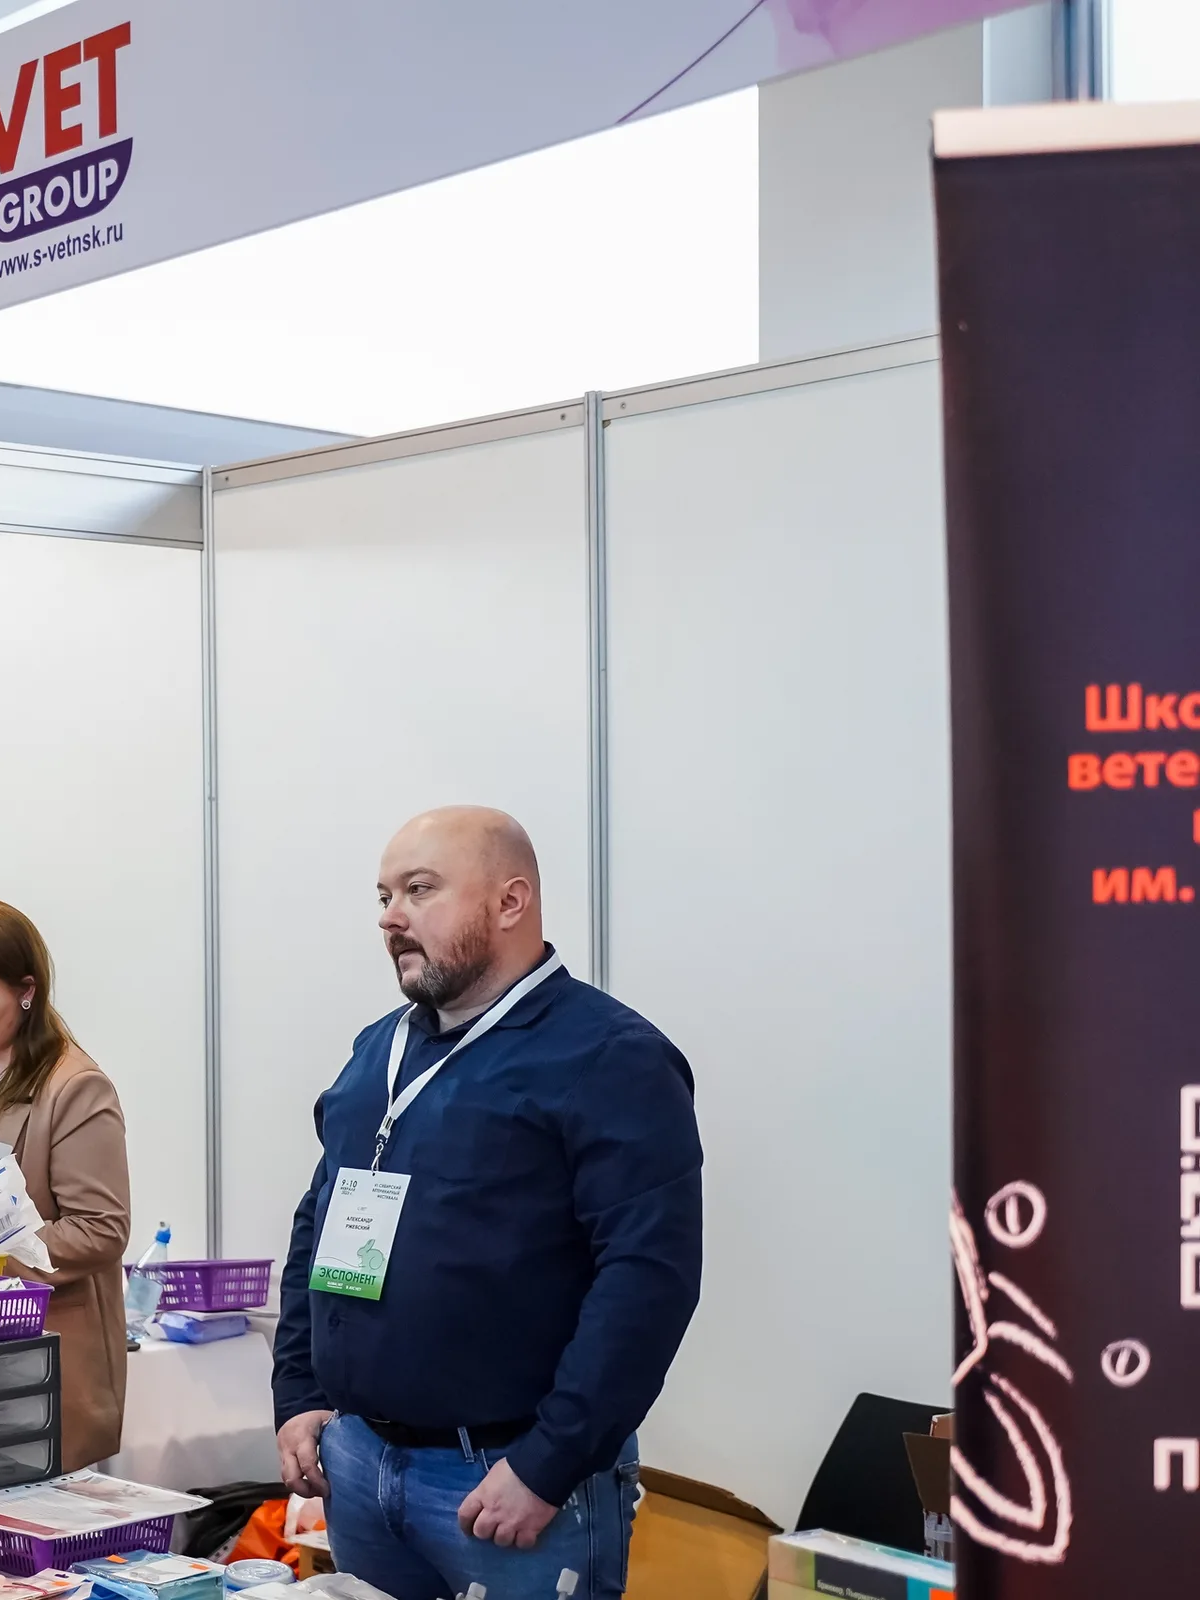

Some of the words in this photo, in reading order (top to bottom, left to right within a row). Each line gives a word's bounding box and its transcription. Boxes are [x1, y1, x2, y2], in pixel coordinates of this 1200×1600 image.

[1067, 750, 1200, 791] вете
[1091, 865, 1196, 905] им.
[318, 1267, 377, 1286] ЭКСПОНЕНТ
